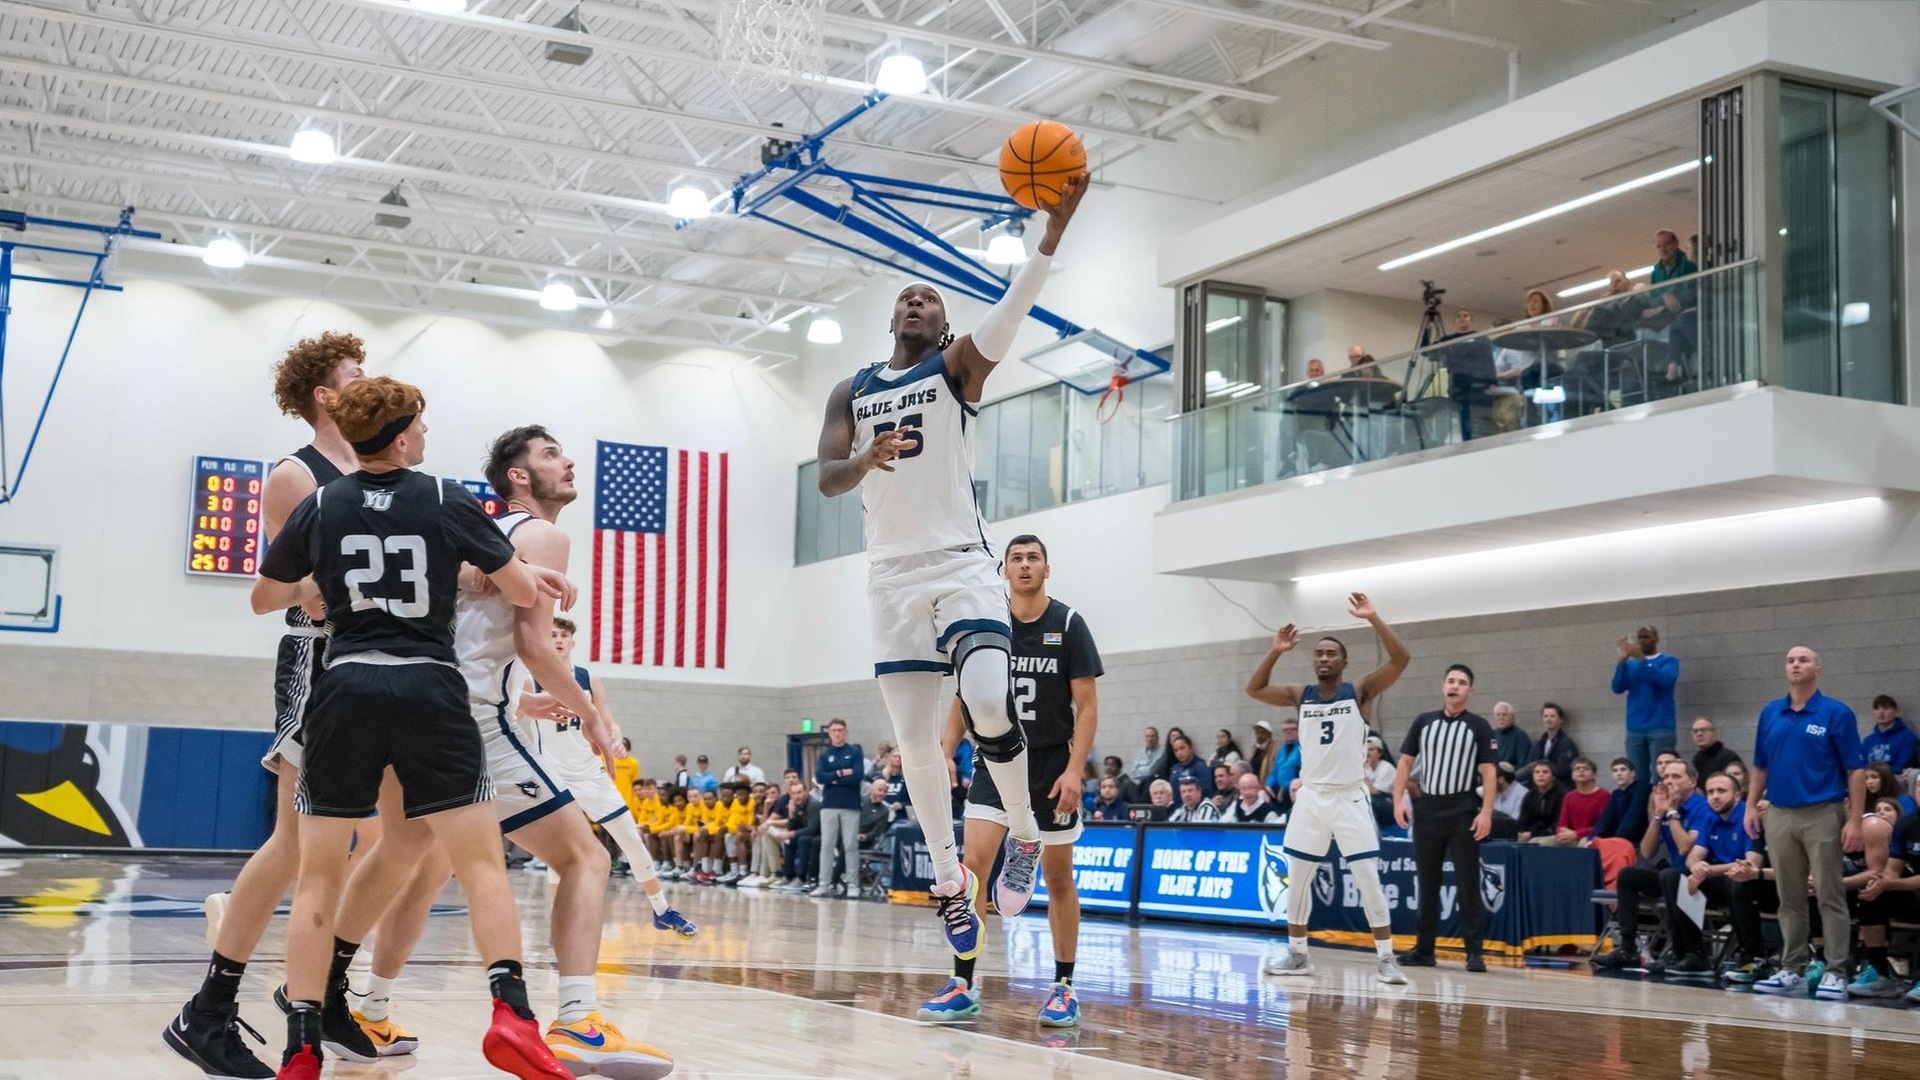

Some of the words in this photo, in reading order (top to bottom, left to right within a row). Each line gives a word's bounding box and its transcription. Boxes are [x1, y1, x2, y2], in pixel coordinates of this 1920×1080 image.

[856, 401, 892, 421] BLUE
[897, 388, 937, 410] JAYS
[207, 475, 220, 492] 0
[223, 478, 234, 492] 0
[249, 480, 259, 494] 0
[207, 495, 219, 512] 3
[222, 497, 233, 512] 0
[247, 499, 258, 514] 0
[362, 489, 396, 511] YU
[485, 500, 495, 515] 0
[199, 516, 217, 530] 11
[220, 517, 231, 532] 0
[246, 519, 257, 533] 0
[193, 534, 216, 550] 24
[219, 536, 230, 551] 0
[244, 538, 255, 553] 2
[191, 553, 214, 571] 25
[217, 556, 229, 571] 0
[243, 558, 254, 573] 0
[340, 534, 430, 618] 23
[1327, 706, 1351, 716] JAYS
[1320, 721, 1334, 745] 3
[1113, 848, 1133, 868] OF
[1152, 849, 1194, 870] HOME
[1194, 850, 1216, 872] OF
[1217, 851, 1250, 873] THE
[1077, 868, 1127, 892] JOSEPH
[1158, 875, 1197, 897] BLUE
[1197, 877, 1234, 899] JAYS
